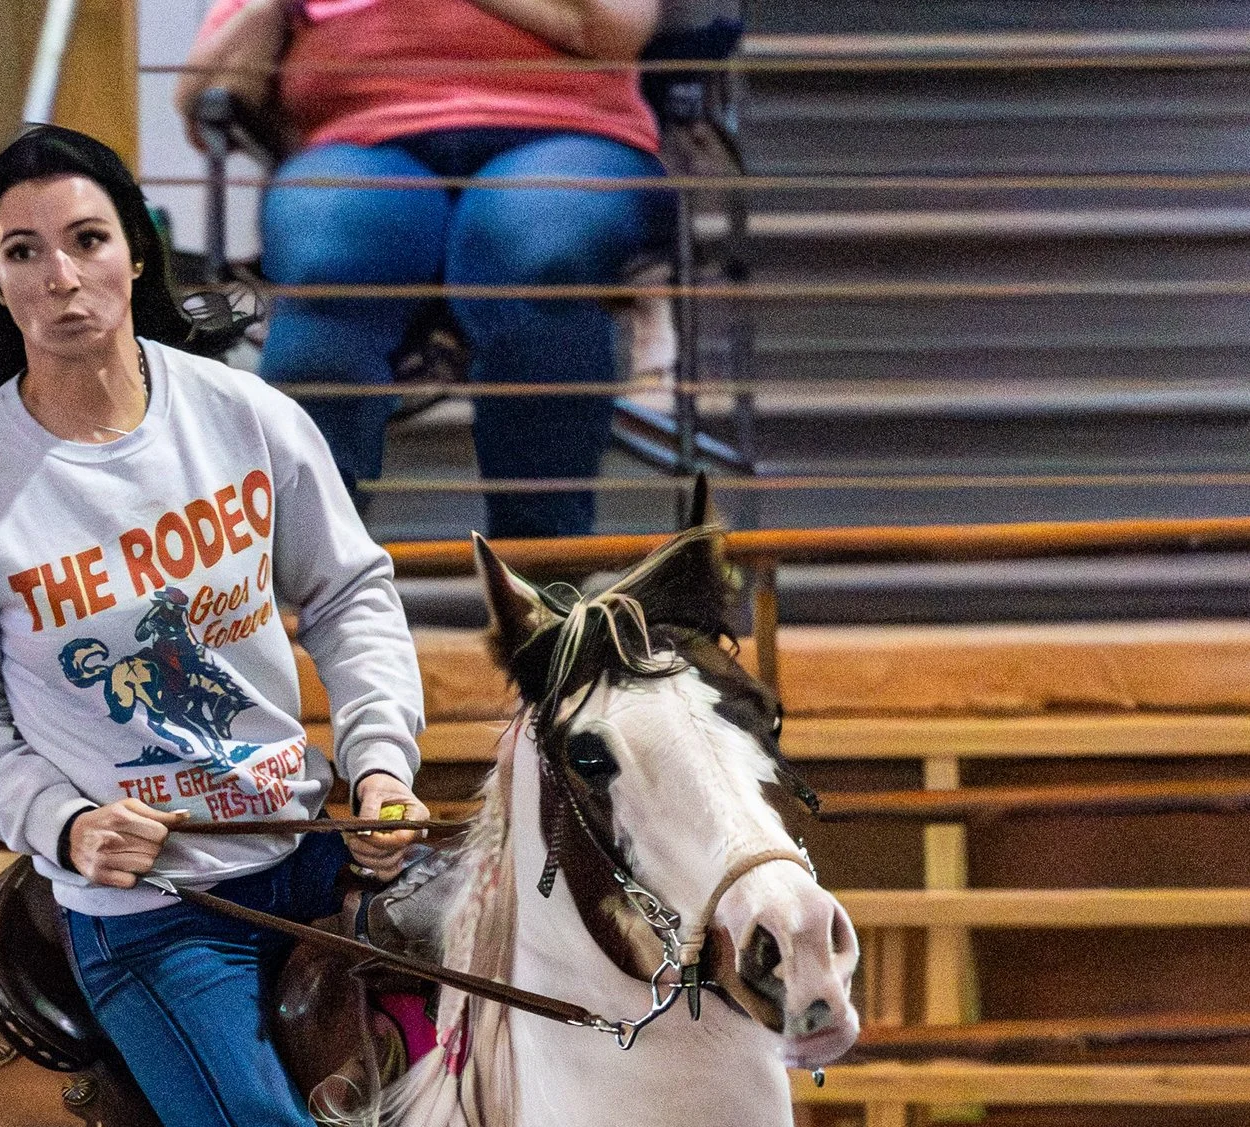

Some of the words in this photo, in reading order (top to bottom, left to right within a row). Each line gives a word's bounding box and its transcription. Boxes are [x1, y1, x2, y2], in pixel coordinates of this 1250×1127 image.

[7, 545, 117, 633] THE
[119, 469, 273, 597] RODEO
[189, 575, 249, 625] Goes
[203, 597, 273, 648] Foreve
[118, 774, 172, 804] THE
[204, 782, 295, 821] PASTIME
